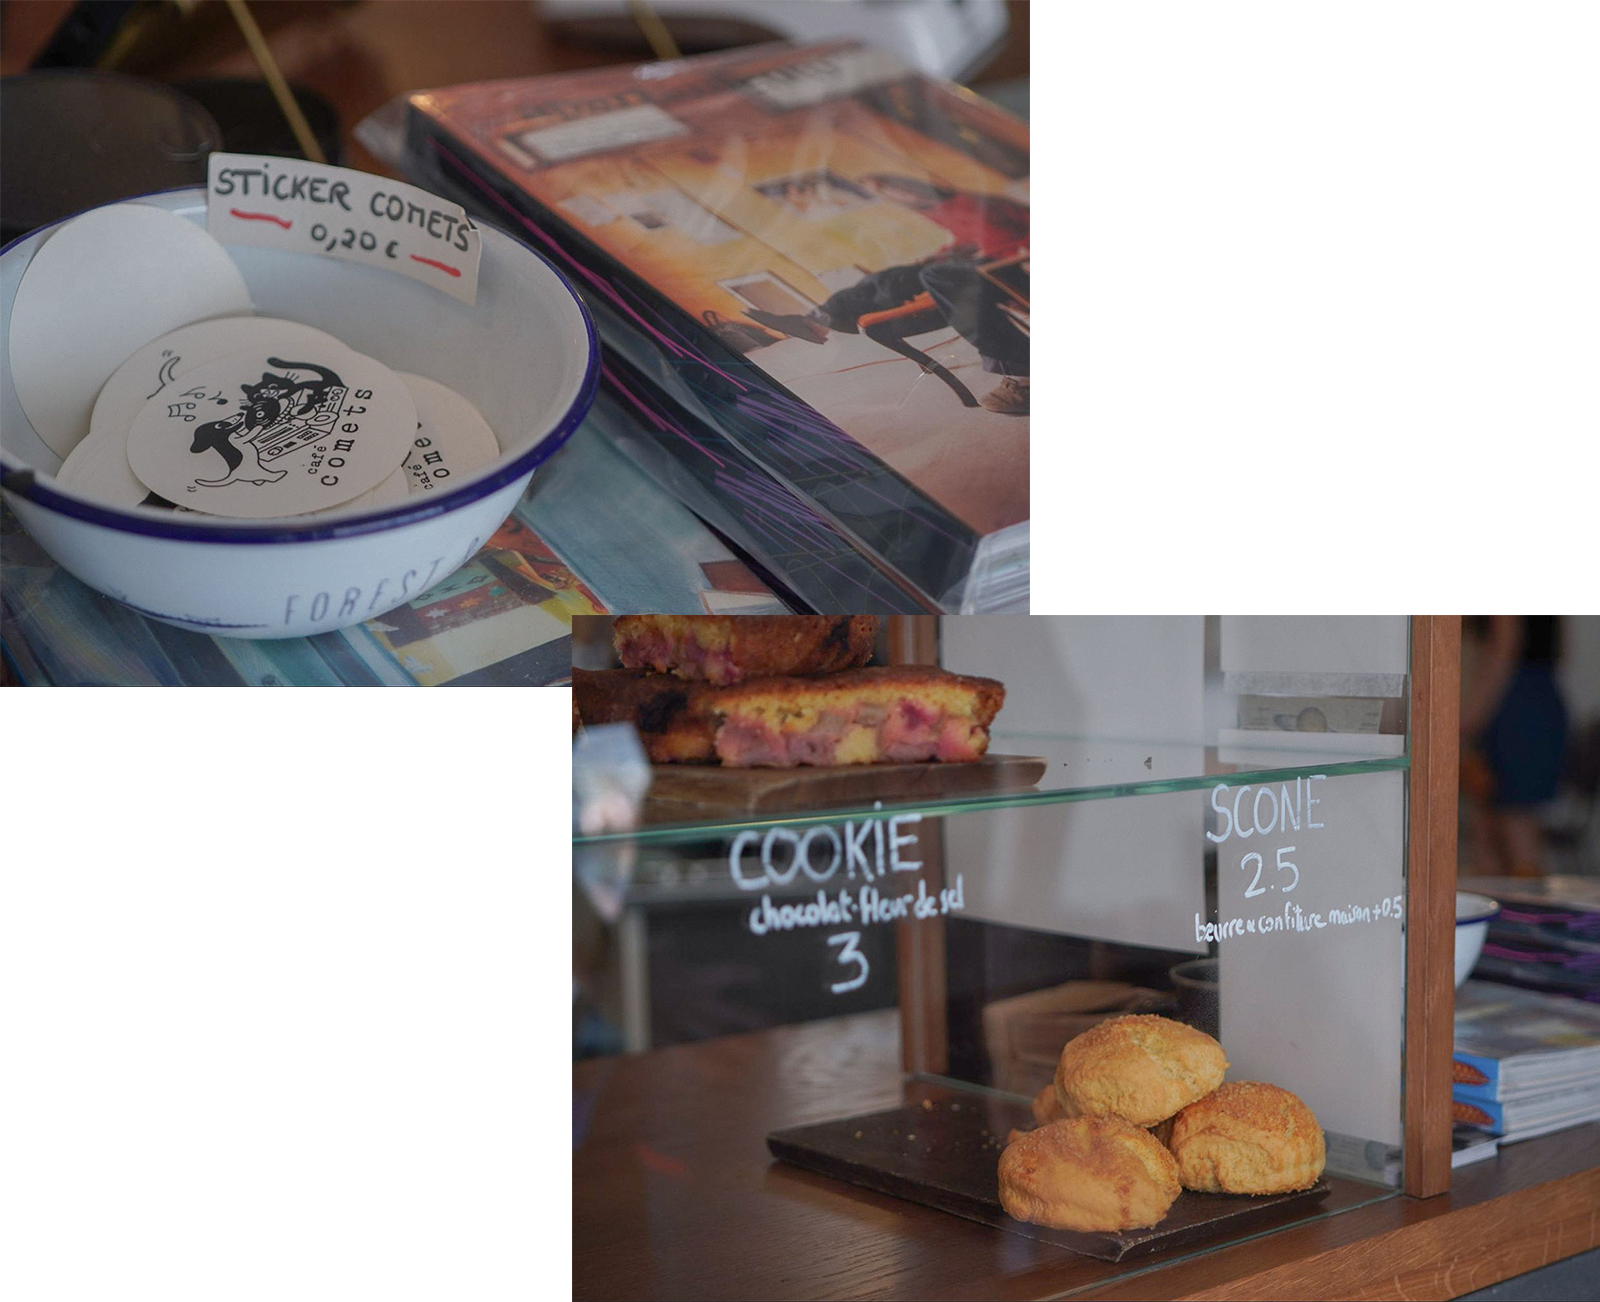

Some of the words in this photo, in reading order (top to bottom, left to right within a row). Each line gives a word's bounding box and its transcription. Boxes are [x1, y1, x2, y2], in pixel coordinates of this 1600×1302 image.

[369, 191, 469, 252] COMETS
[308, 445, 327, 475] café
[321, 389, 373, 486] comets
[284, 556, 444, 625] FOREST
[1206, 774, 1327, 843] SCONE
[914, 878, 938, 920] de
[940, 873, 965, 915] sel
[1240, 846, 1300, 899] 2.5
[1195, 912, 1246, 943] beurre
[1257, 901, 1327, 932] confiture
[1328, 904, 1370, 925] maison
[826, 930, 870, 994] 3
